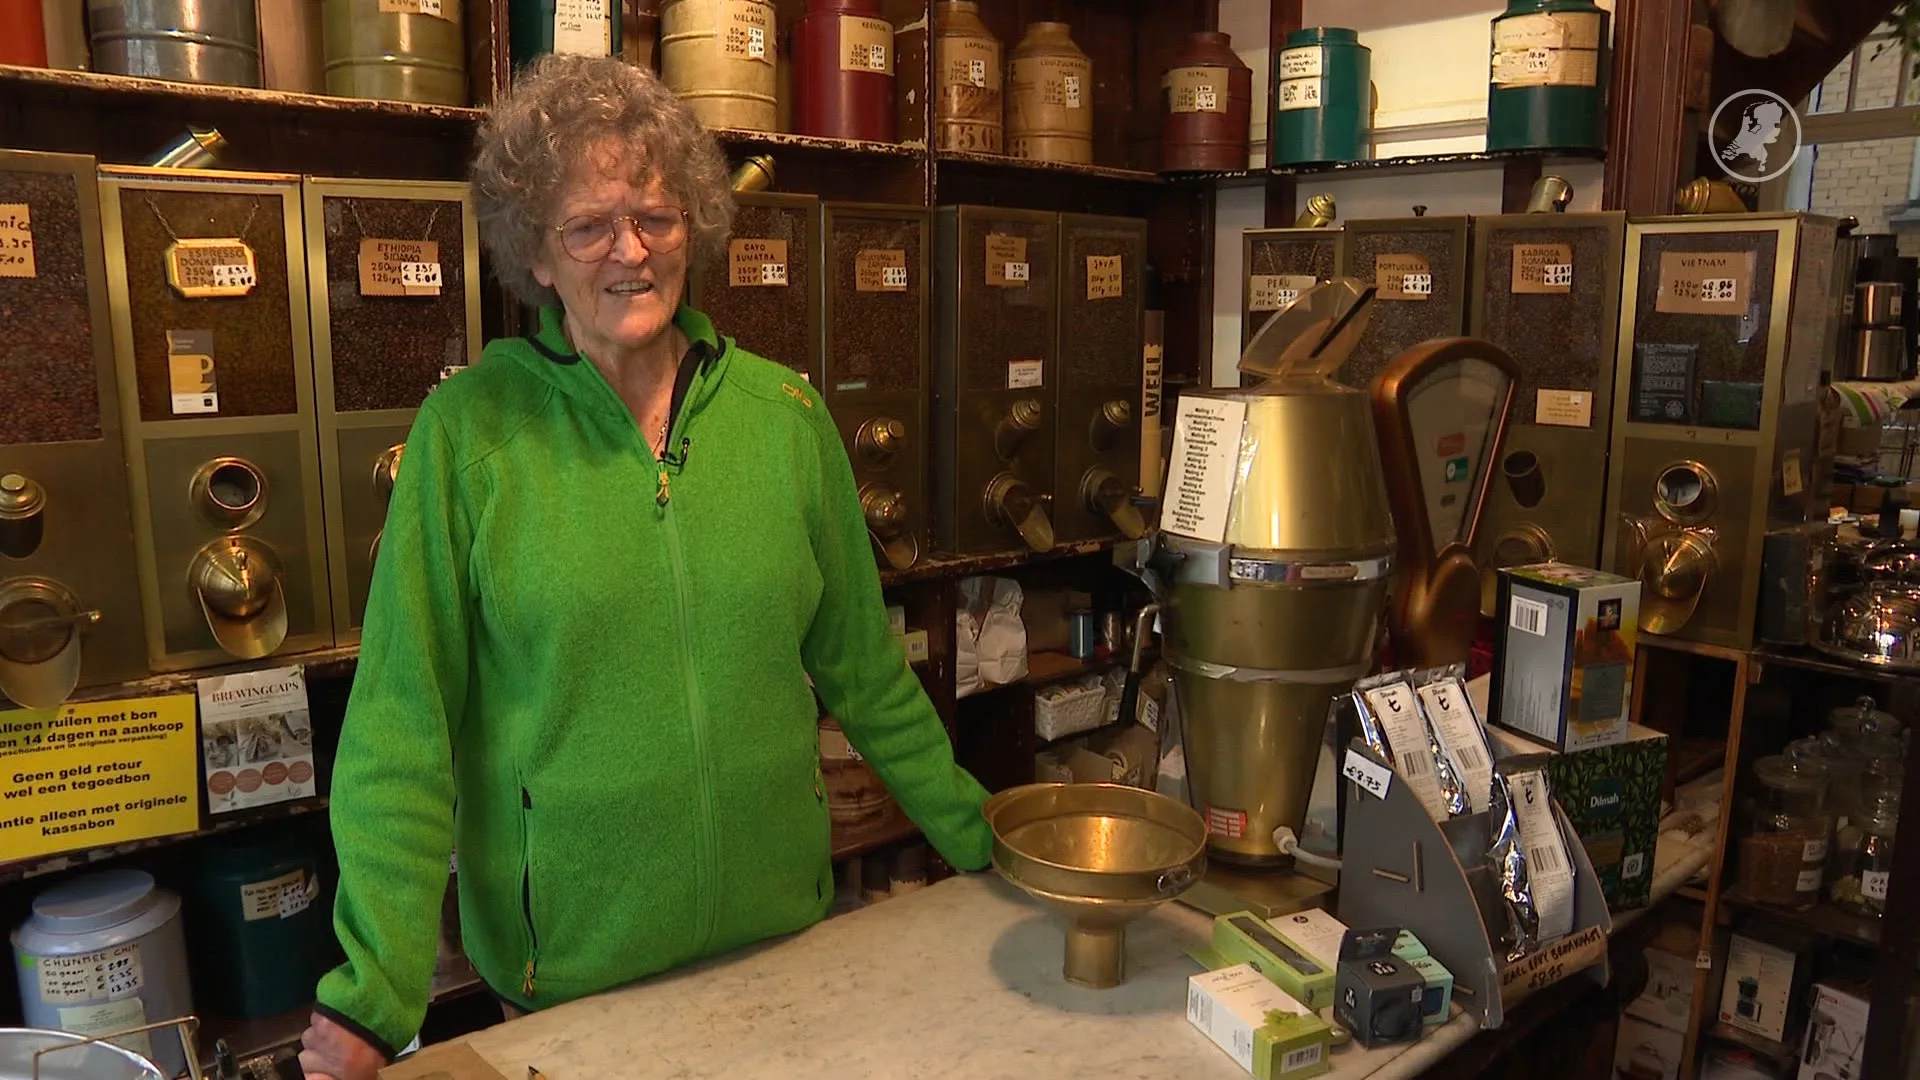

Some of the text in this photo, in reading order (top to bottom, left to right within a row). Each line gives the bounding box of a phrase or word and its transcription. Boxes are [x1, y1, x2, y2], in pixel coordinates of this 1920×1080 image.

[188, 248, 243, 258] ESPRESSO
[378, 243, 422, 254] ETHIOPIA
[384, 253, 420, 263] SIDAMO
[736, 254, 776, 262] SUMATRA
[1094, 260, 1114, 270] JAVA
[1681, 259, 1727, 268] VIETNAM
[1267, 279, 1290, 288] PERU
[211, 681, 299, 703] BREWINGCAPS
[48, 715, 92, 729] ruilen
[97, 712, 126, 724] met
[131, 709, 158, 720] bon
[24, 734, 42, 744] 14
[47, 727, 94, 743] dagen
[99, 727, 118, 738] na
[122, 721, 184, 736] aankoop
[78, 738, 116, 748] originele
[13, 760, 143, 783] Geen geld retour
[4, 773, 151, 800] wel een tegoedbon
[1590, 793, 1619, 808] Dilmah
[0, 795, 188, 829] ntie alleen met originele
[42, 818, 116, 837] kassabon
[43, 953, 107, 967] CHUNMEE
